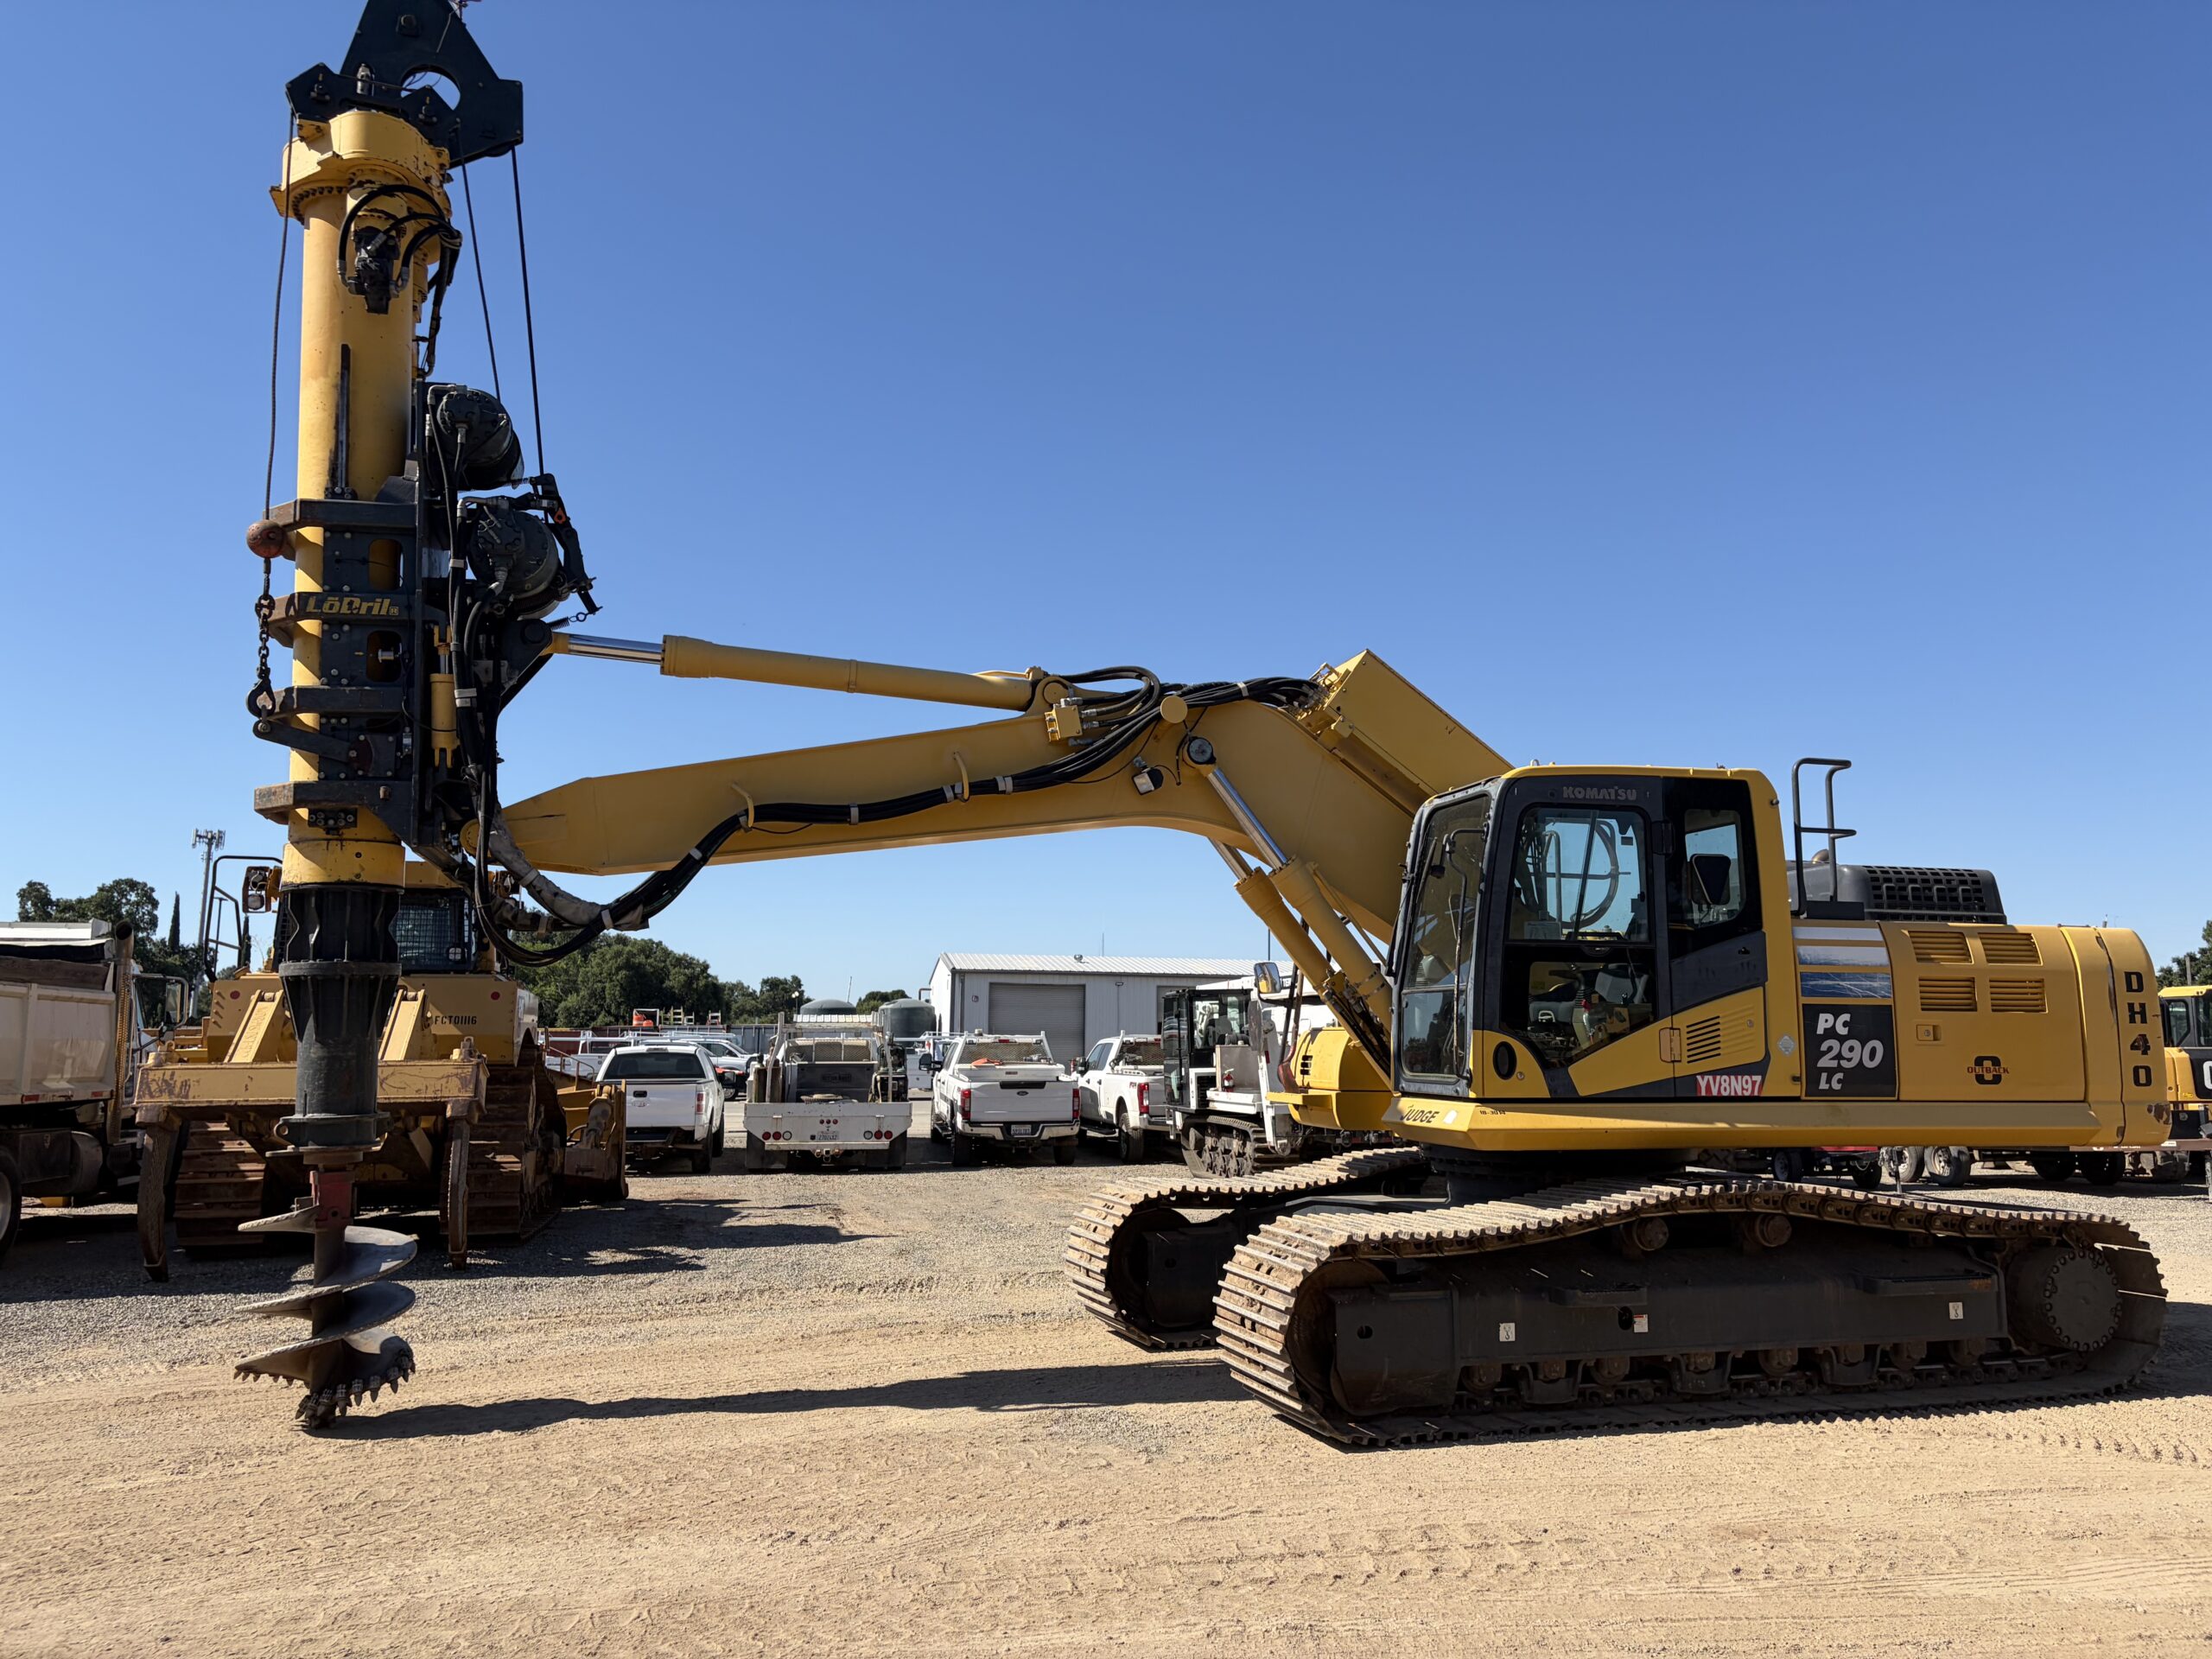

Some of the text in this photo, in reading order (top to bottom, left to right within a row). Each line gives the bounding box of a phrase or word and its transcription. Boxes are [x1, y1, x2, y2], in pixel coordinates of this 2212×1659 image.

[1562, 785, 1637, 801] KOMATSU
[1816, 1013, 1851, 1035] PC
[1816, 1039, 1884, 1069] 290
[1967, 1066, 2010, 1075] OUTBACK
[1696, 1075, 1762, 1096] YV8N97
[1818, 1072, 1844, 1090] LC
[1400, 1109, 1440, 1124] JUDGE
